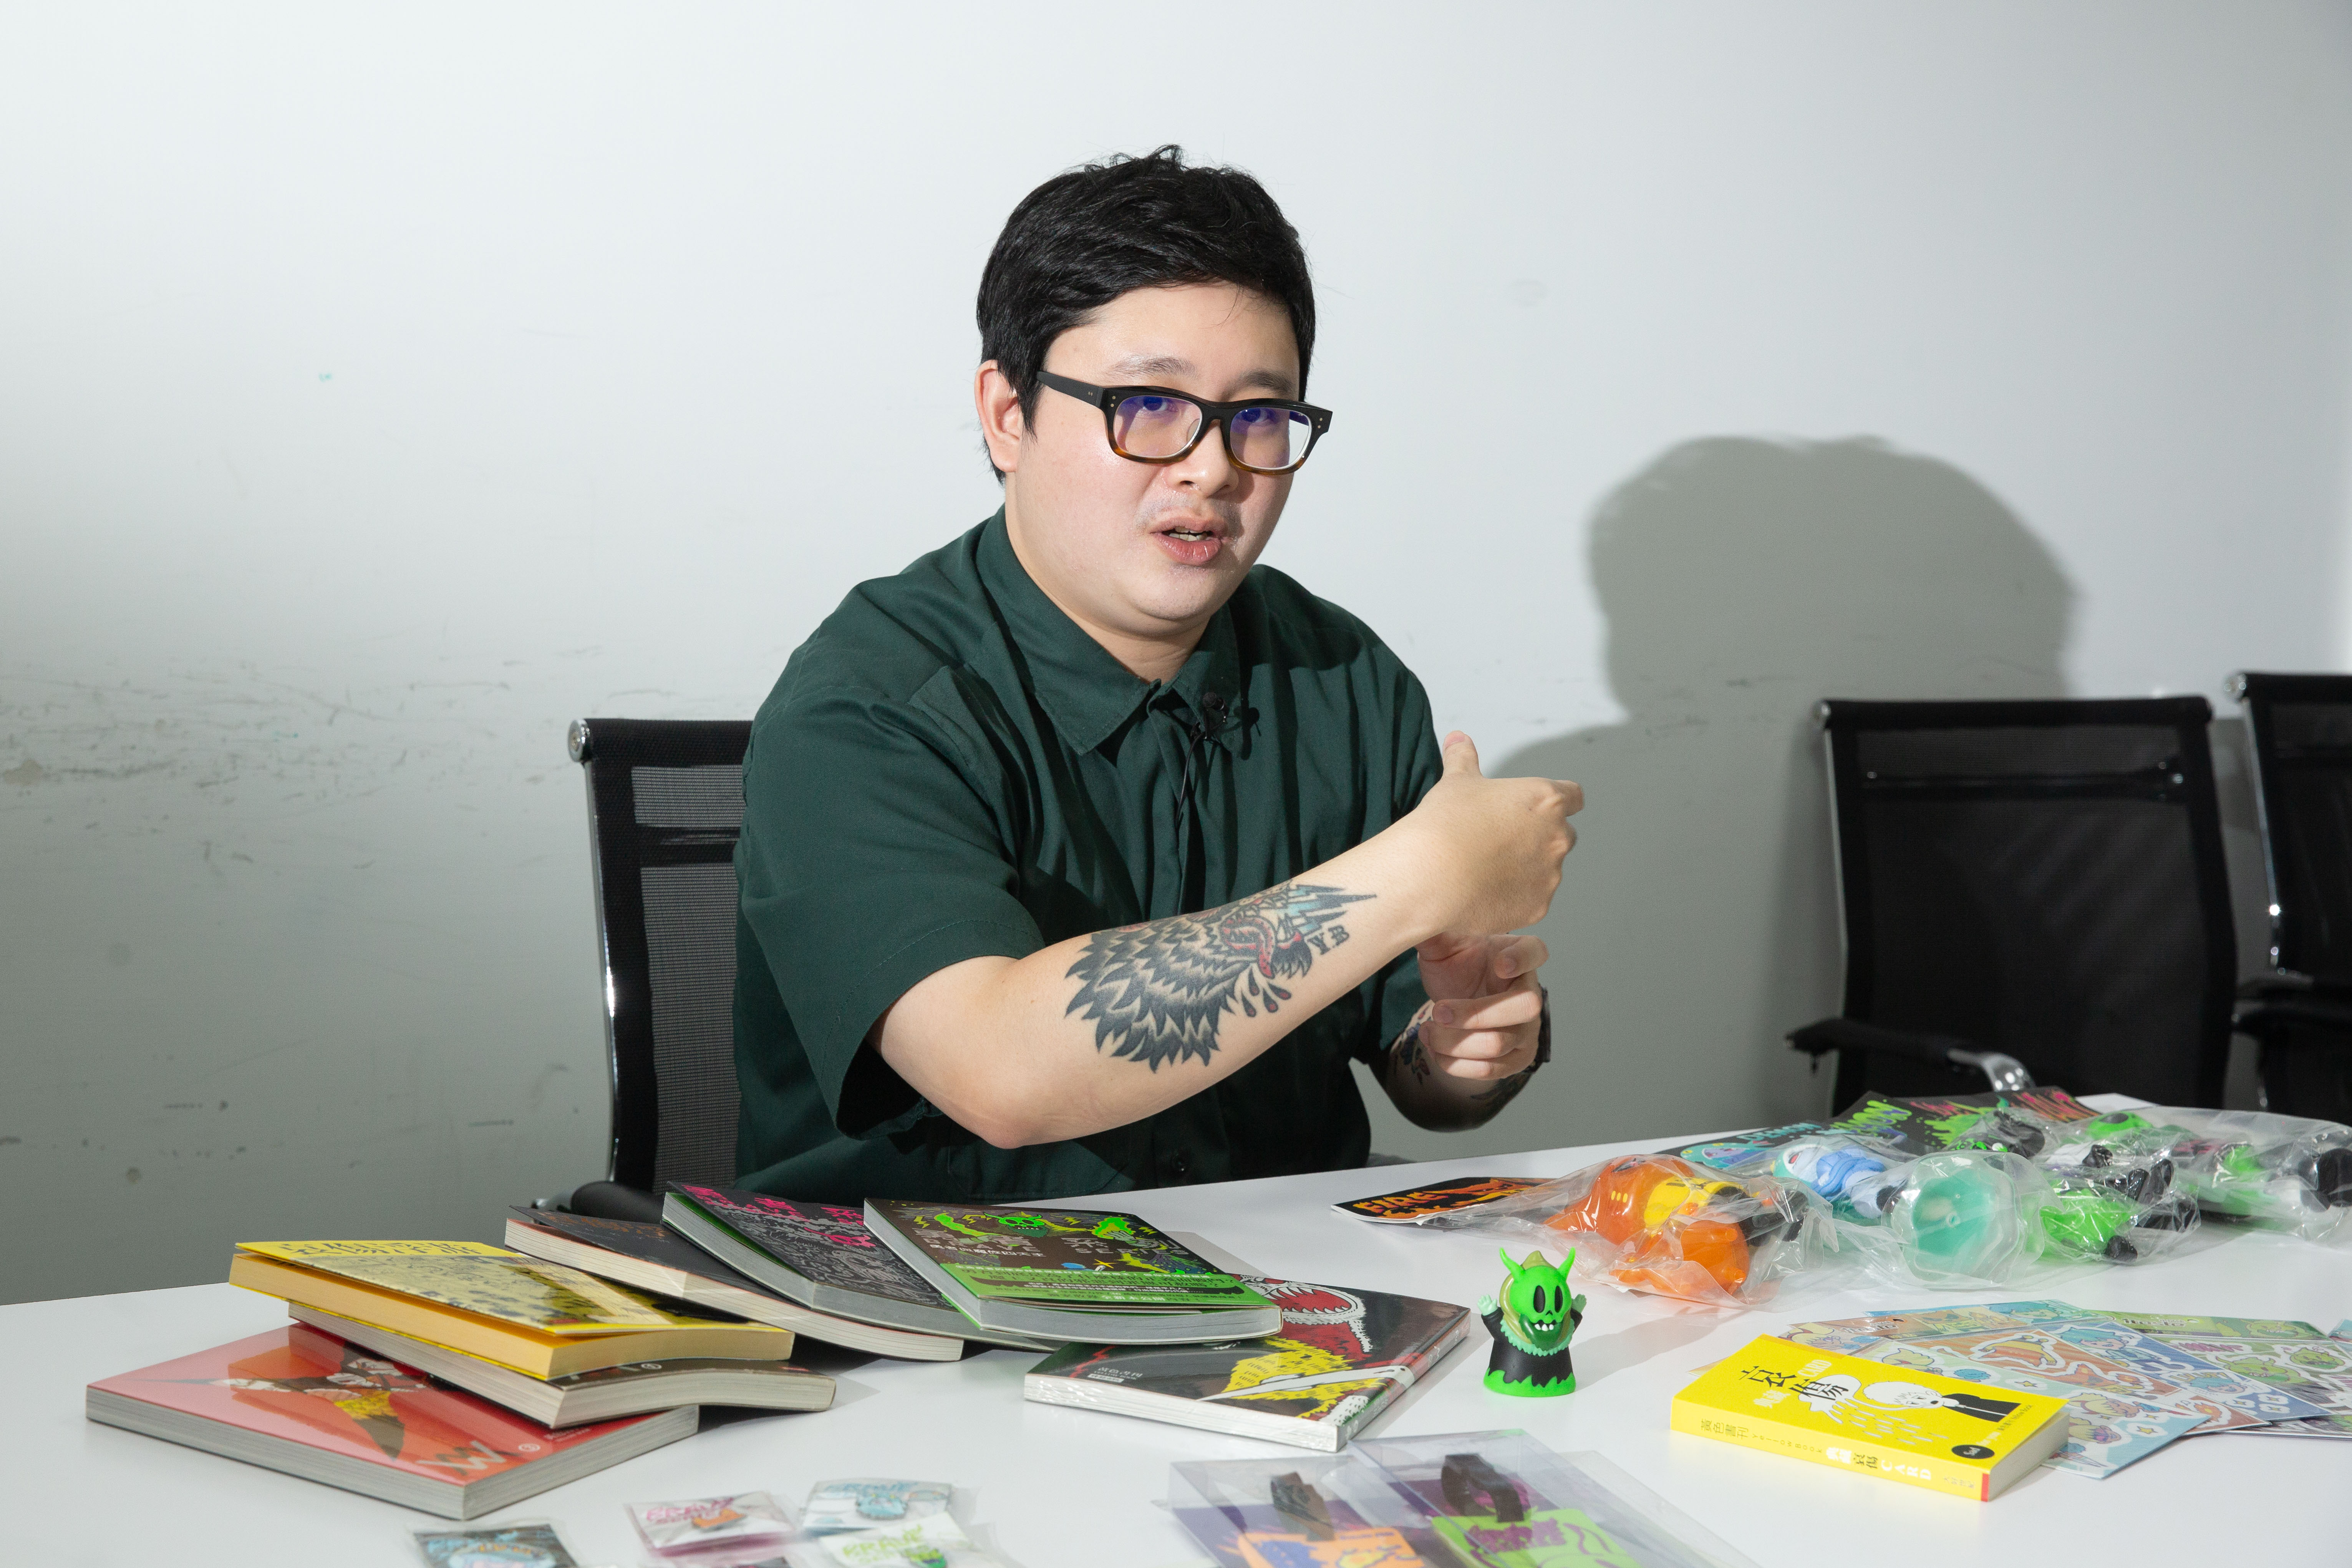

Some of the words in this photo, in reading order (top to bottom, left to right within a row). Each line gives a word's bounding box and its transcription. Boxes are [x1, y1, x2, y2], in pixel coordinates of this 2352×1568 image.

[1353, 1192, 1449, 1213] FIRE
[923, 1239, 1041, 1252] BRAVE
[1797, 1359, 1832, 1377] CARD
[1739, 1366, 1848, 1401] 哀傷
[1701, 1418, 1749, 1440] 黃色書刊
[1881, 1459, 1931, 1481] CARD
